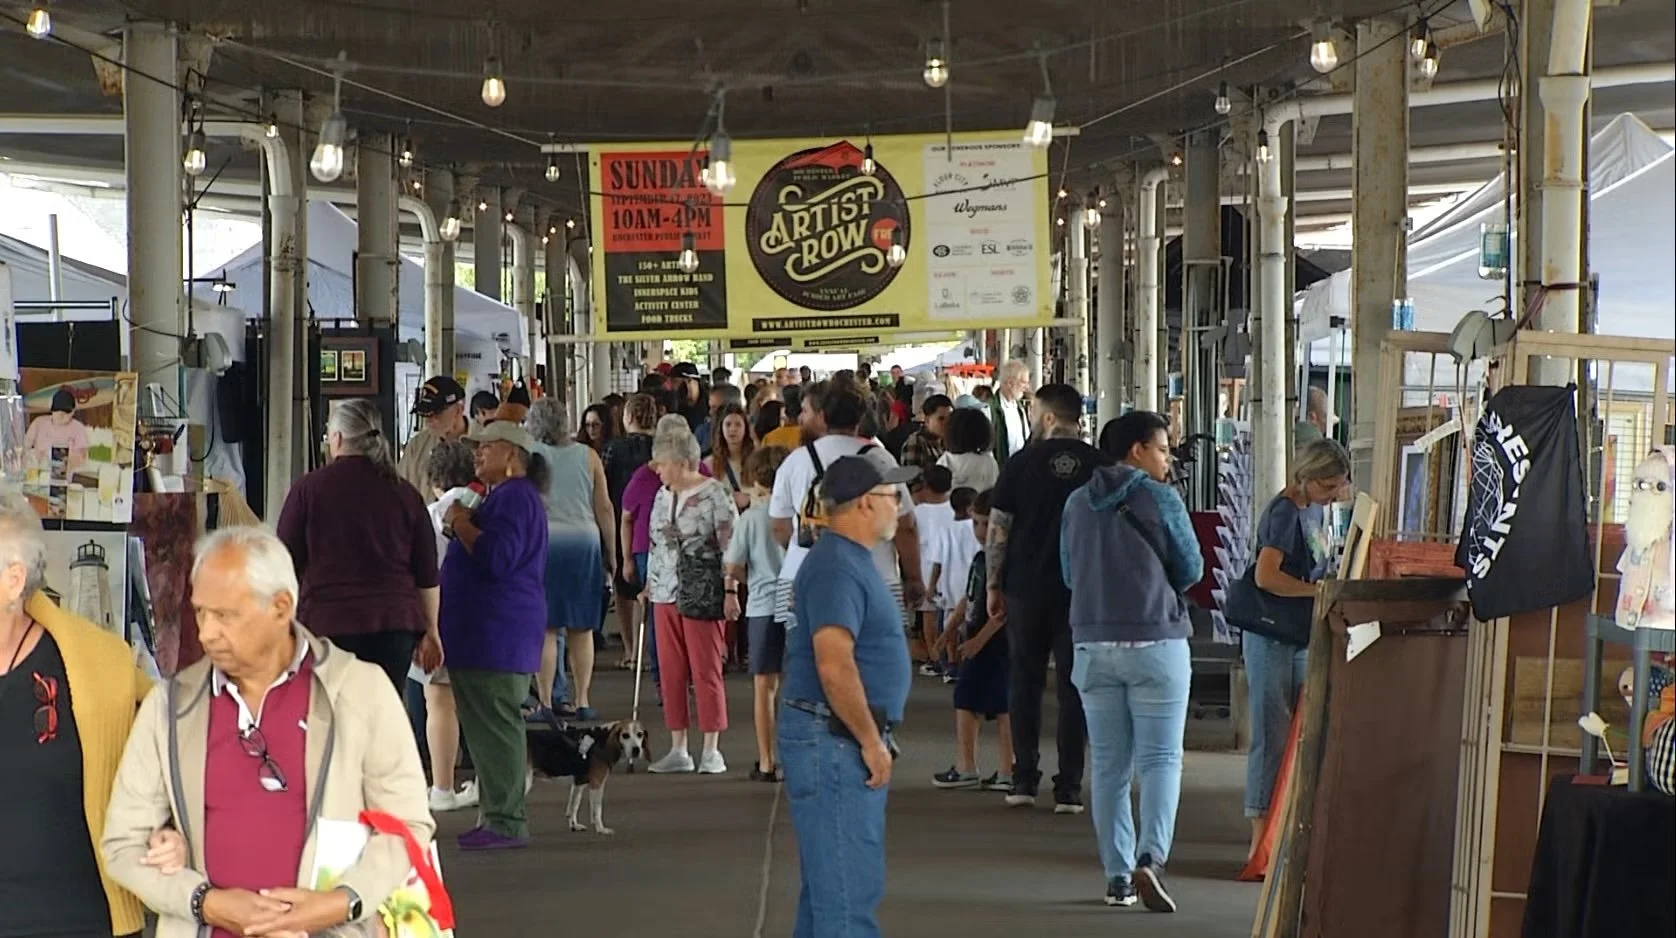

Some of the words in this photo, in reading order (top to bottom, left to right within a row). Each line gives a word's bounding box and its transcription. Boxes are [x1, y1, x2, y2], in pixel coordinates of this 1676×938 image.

[954, 199, 1007, 218] Wegmans
[613, 207, 711, 229] 10AM-4PM
[761, 186, 876, 254] ARTIST
[873, 227, 897, 240] FRE
[801, 219, 868, 268] ROW
[981, 244, 1000, 254] ESL
[638, 261, 658, 270] 150+
[618, 275, 632, 284] THE
[680, 287, 698, 296] KIDS
[635, 301, 669, 310] ACTIVITY
[671, 300, 699, 309] CENTER
[641, 314, 662, 324] FOOD
[664, 314, 693, 323] TRUCKS
